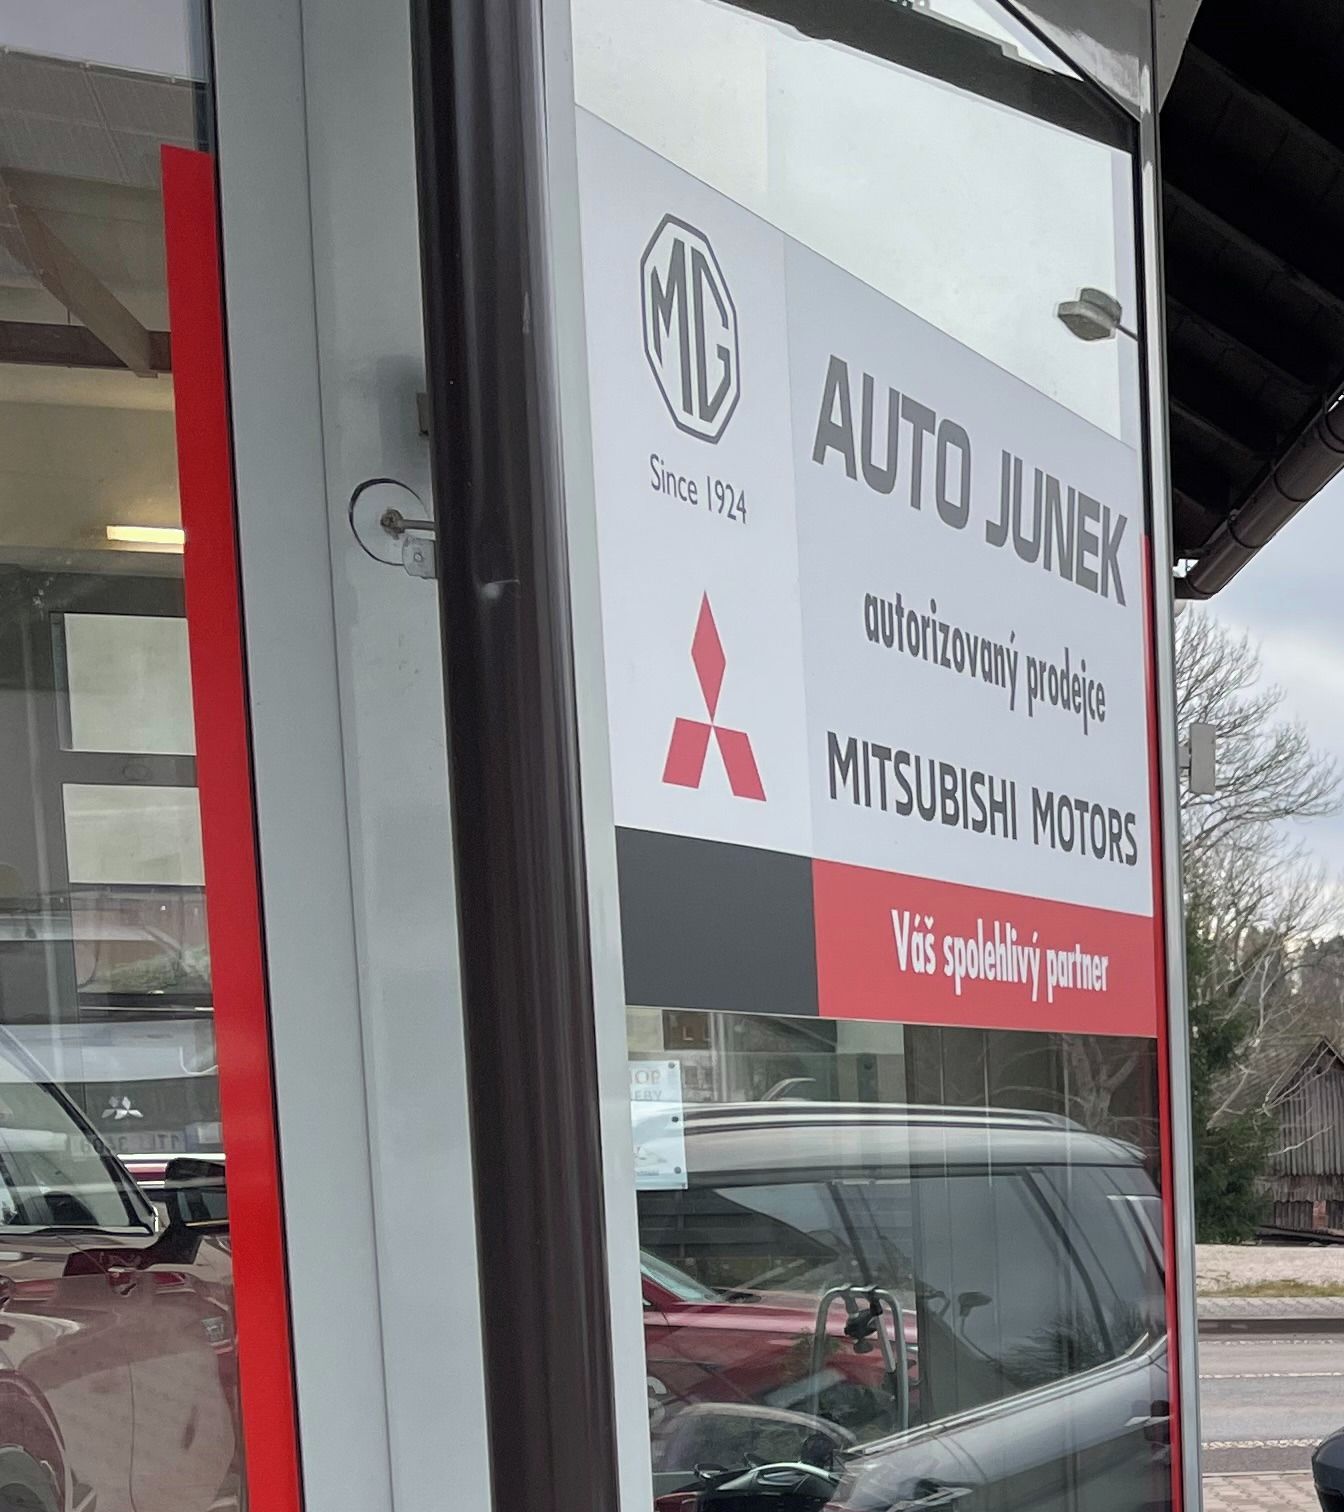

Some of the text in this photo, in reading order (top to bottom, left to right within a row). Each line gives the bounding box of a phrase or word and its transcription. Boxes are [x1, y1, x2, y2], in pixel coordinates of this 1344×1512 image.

[651, 238, 732, 423] MG
[650, 454, 746, 524] Since 1924
[812, 354, 1128, 607] AUTO JUNEK
[864, 592, 1106, 736] autorizovaný prodejce
[827, 731, 1138, 866] MITSUBISHI MOTORS
[891, 909, 1109, 1004] Váš spolehlivý partner
